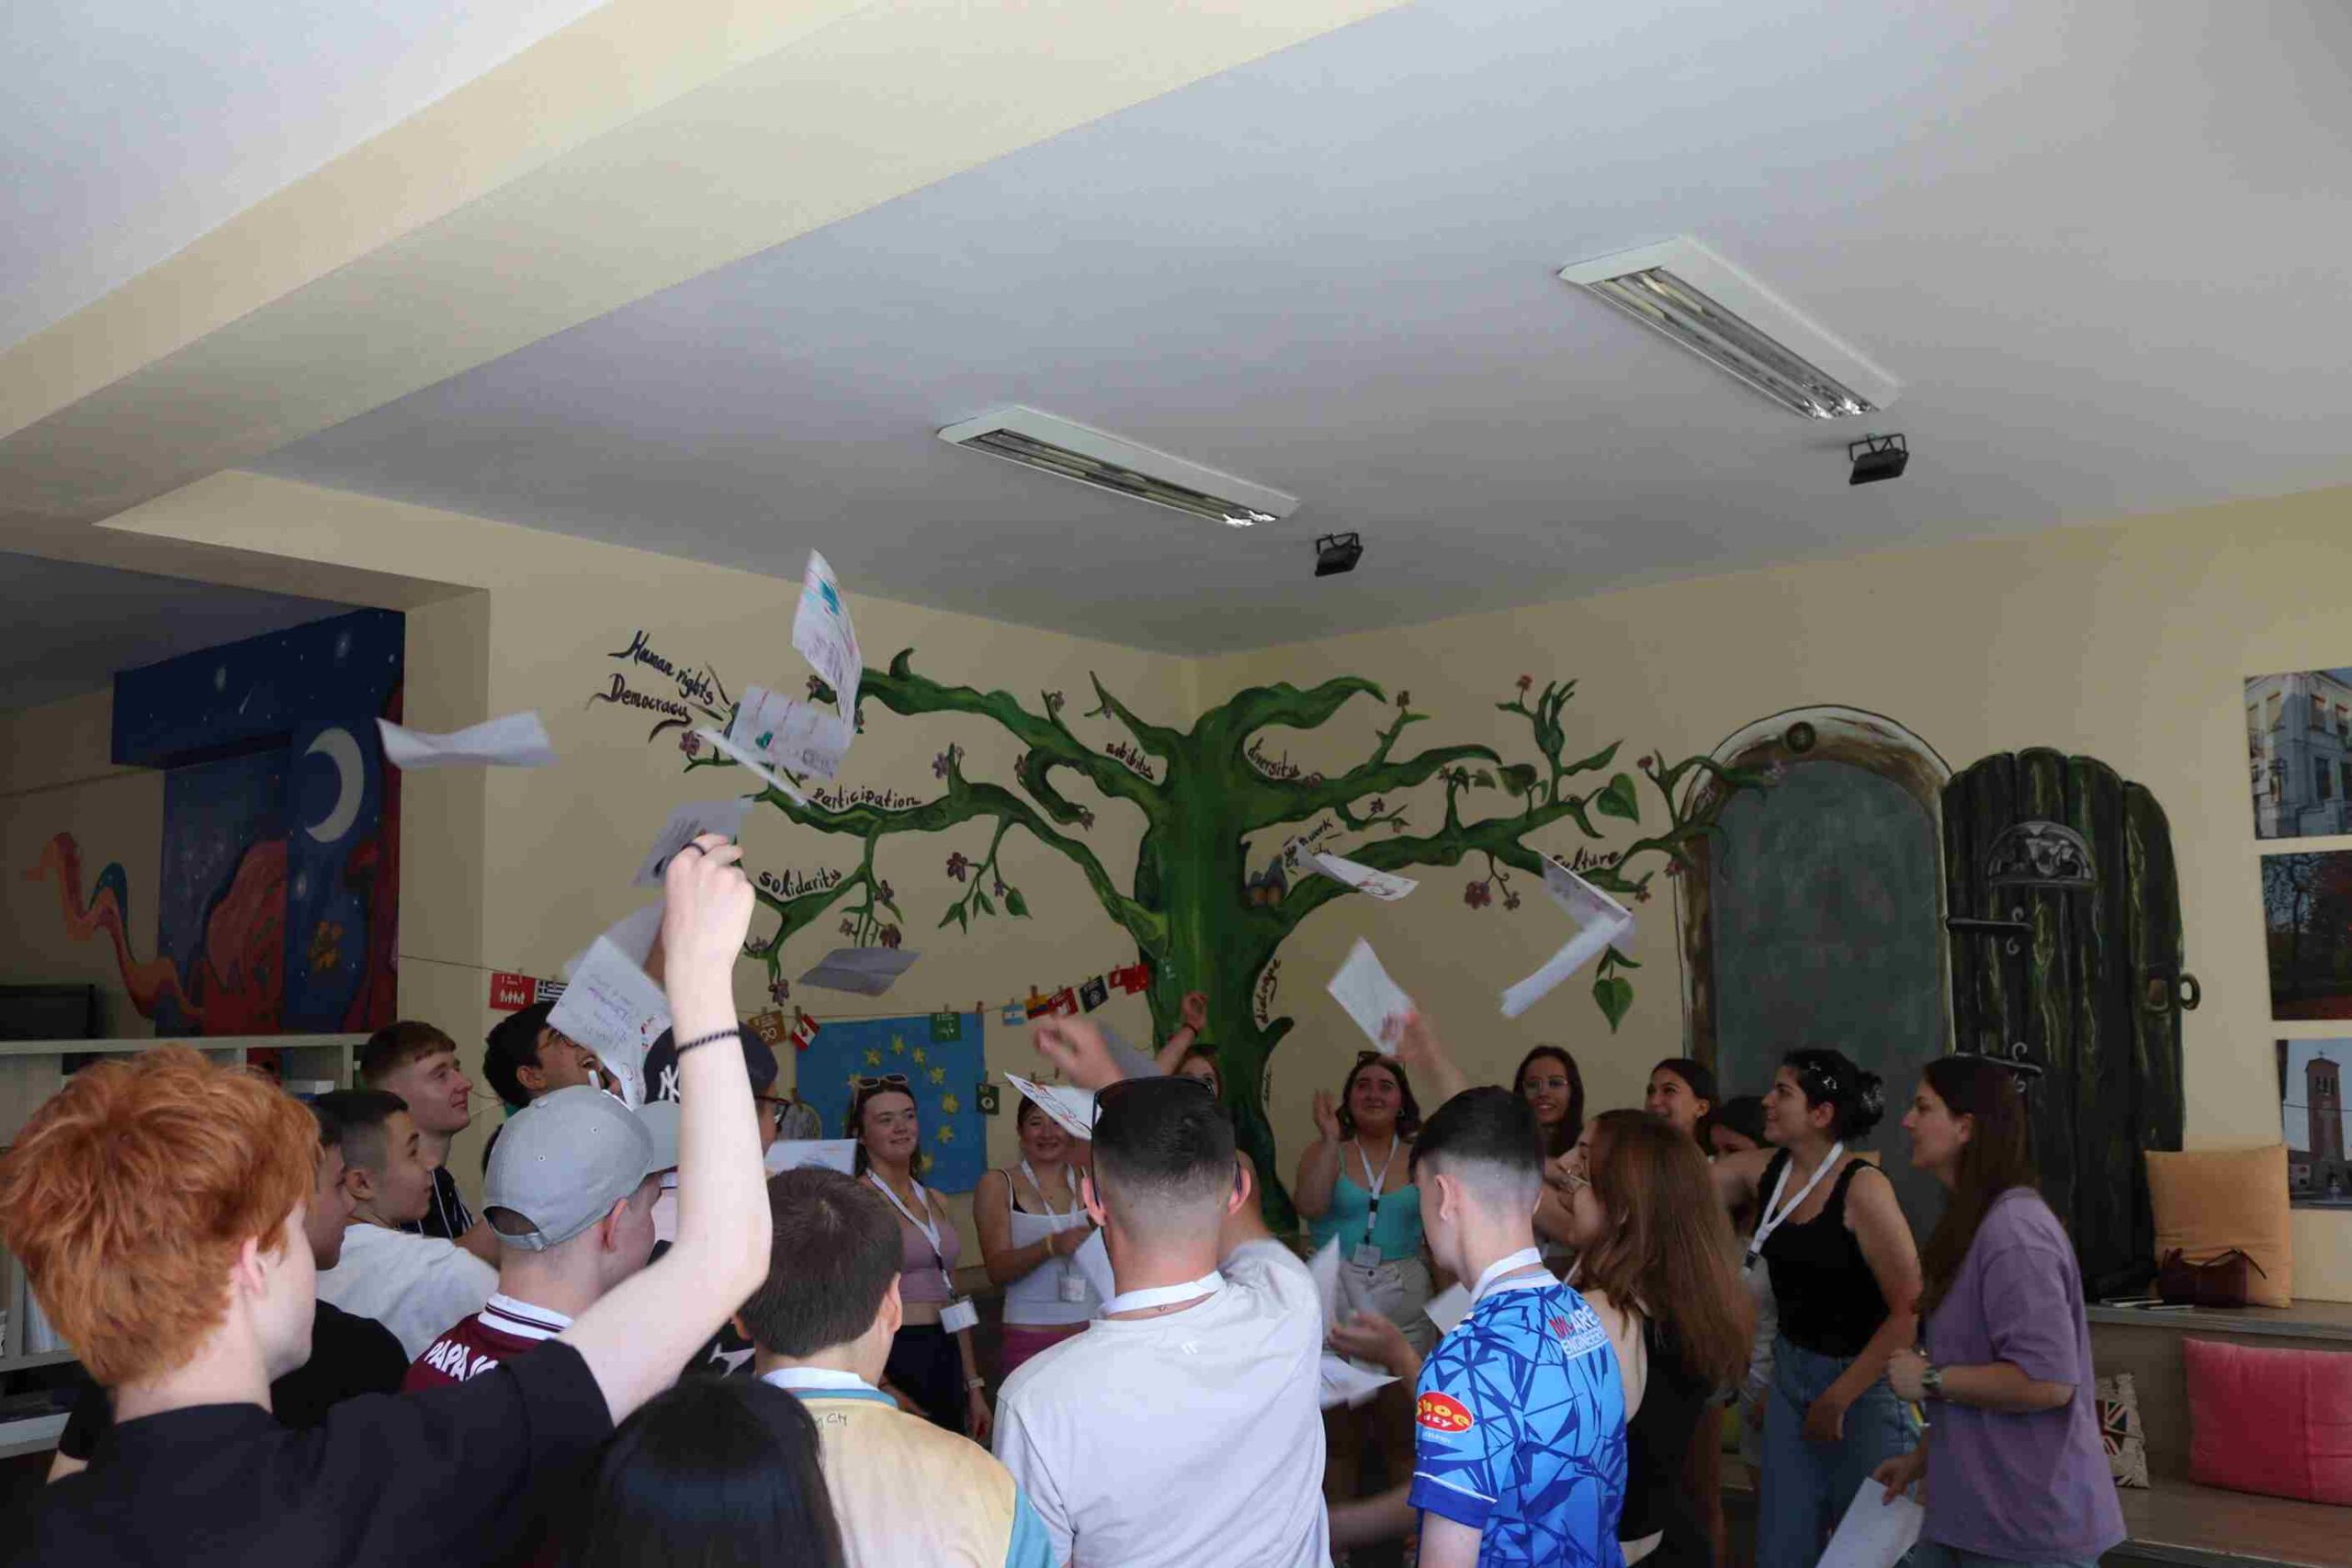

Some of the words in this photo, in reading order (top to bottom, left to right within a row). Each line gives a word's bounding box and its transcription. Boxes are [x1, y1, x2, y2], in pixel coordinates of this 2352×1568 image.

[607, 630, 675, 676] Human
[675, 668, 714, 705] rights
[587, 673, 693, 743] Democracy
[424, 1339, 470, 1382] PAPA
